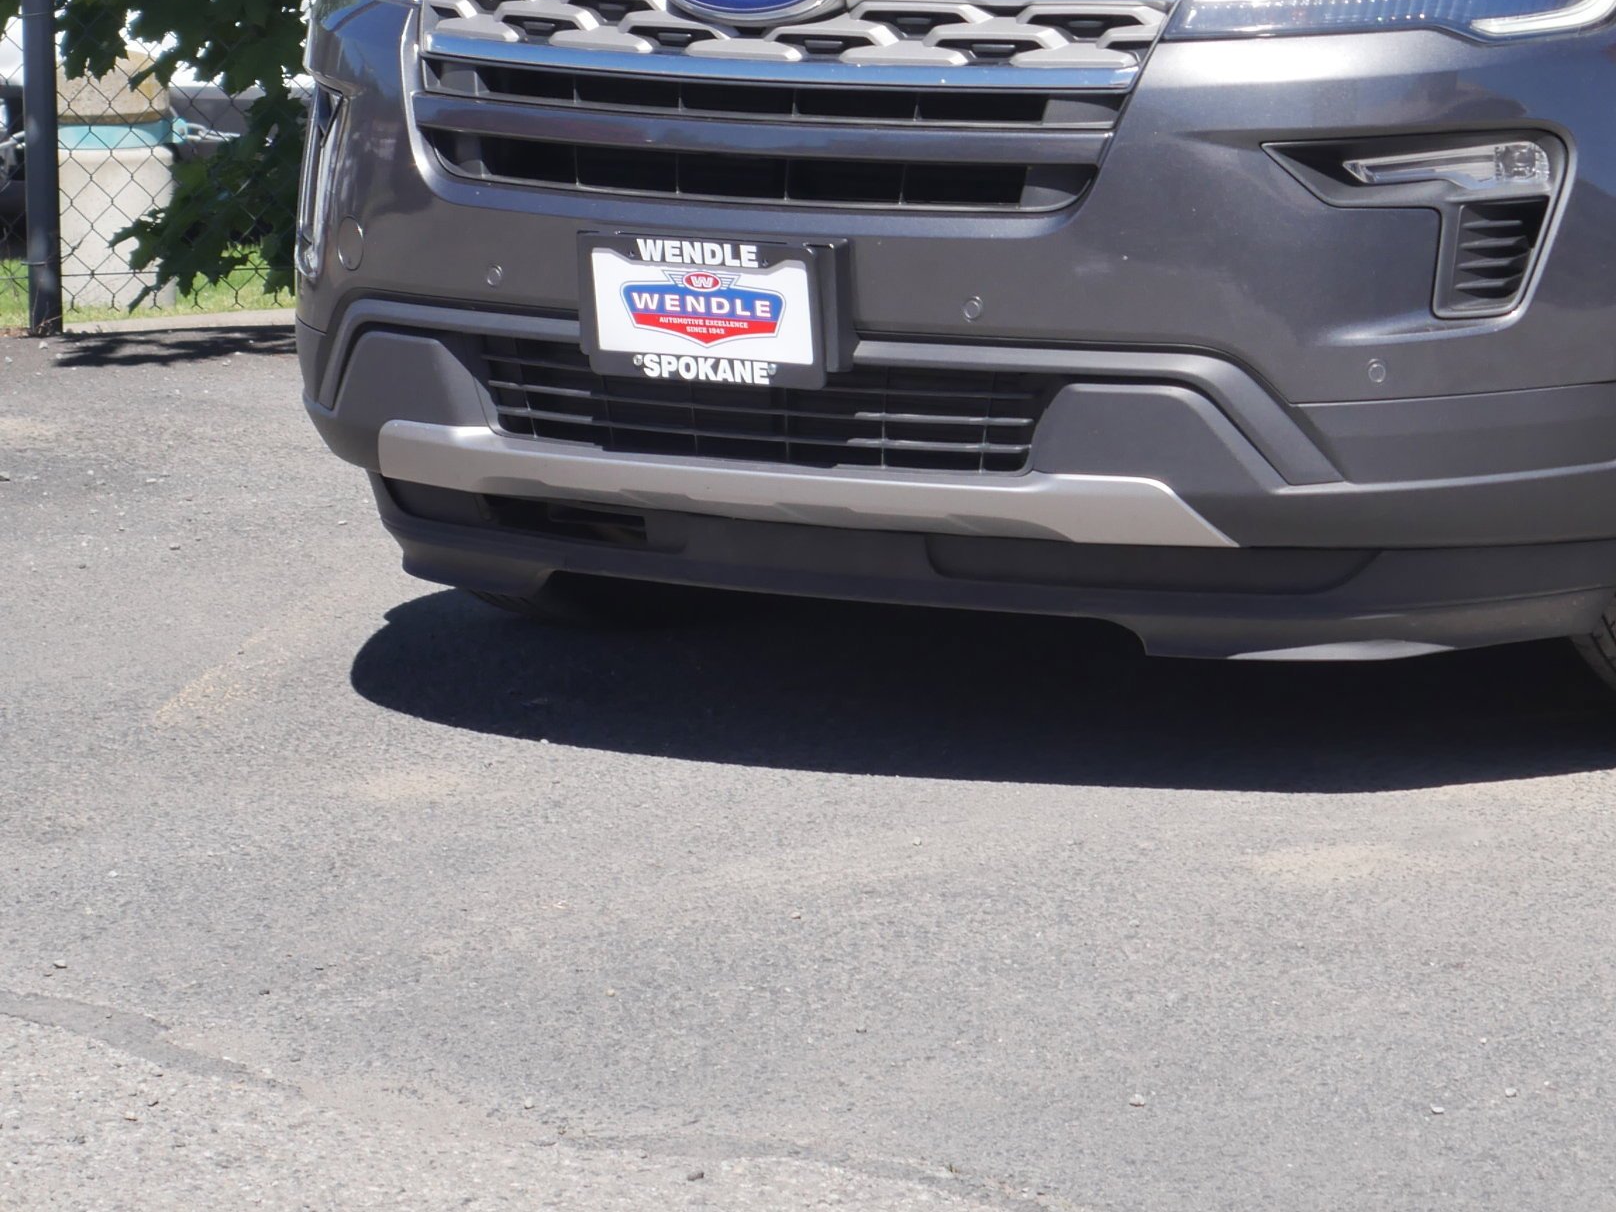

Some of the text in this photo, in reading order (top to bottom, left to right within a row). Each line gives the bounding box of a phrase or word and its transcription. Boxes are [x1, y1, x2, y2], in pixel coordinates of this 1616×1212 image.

[635, 238, 759, 269] WENDLE
[631, 291, 772, 318] WENDLE
[659, 316, 749, 329] AUTOMOTIVE EXCELLENCE
[686, 326, 726, 335] SINCE 1943
[642, 353, 770, 385] SPOKANE
